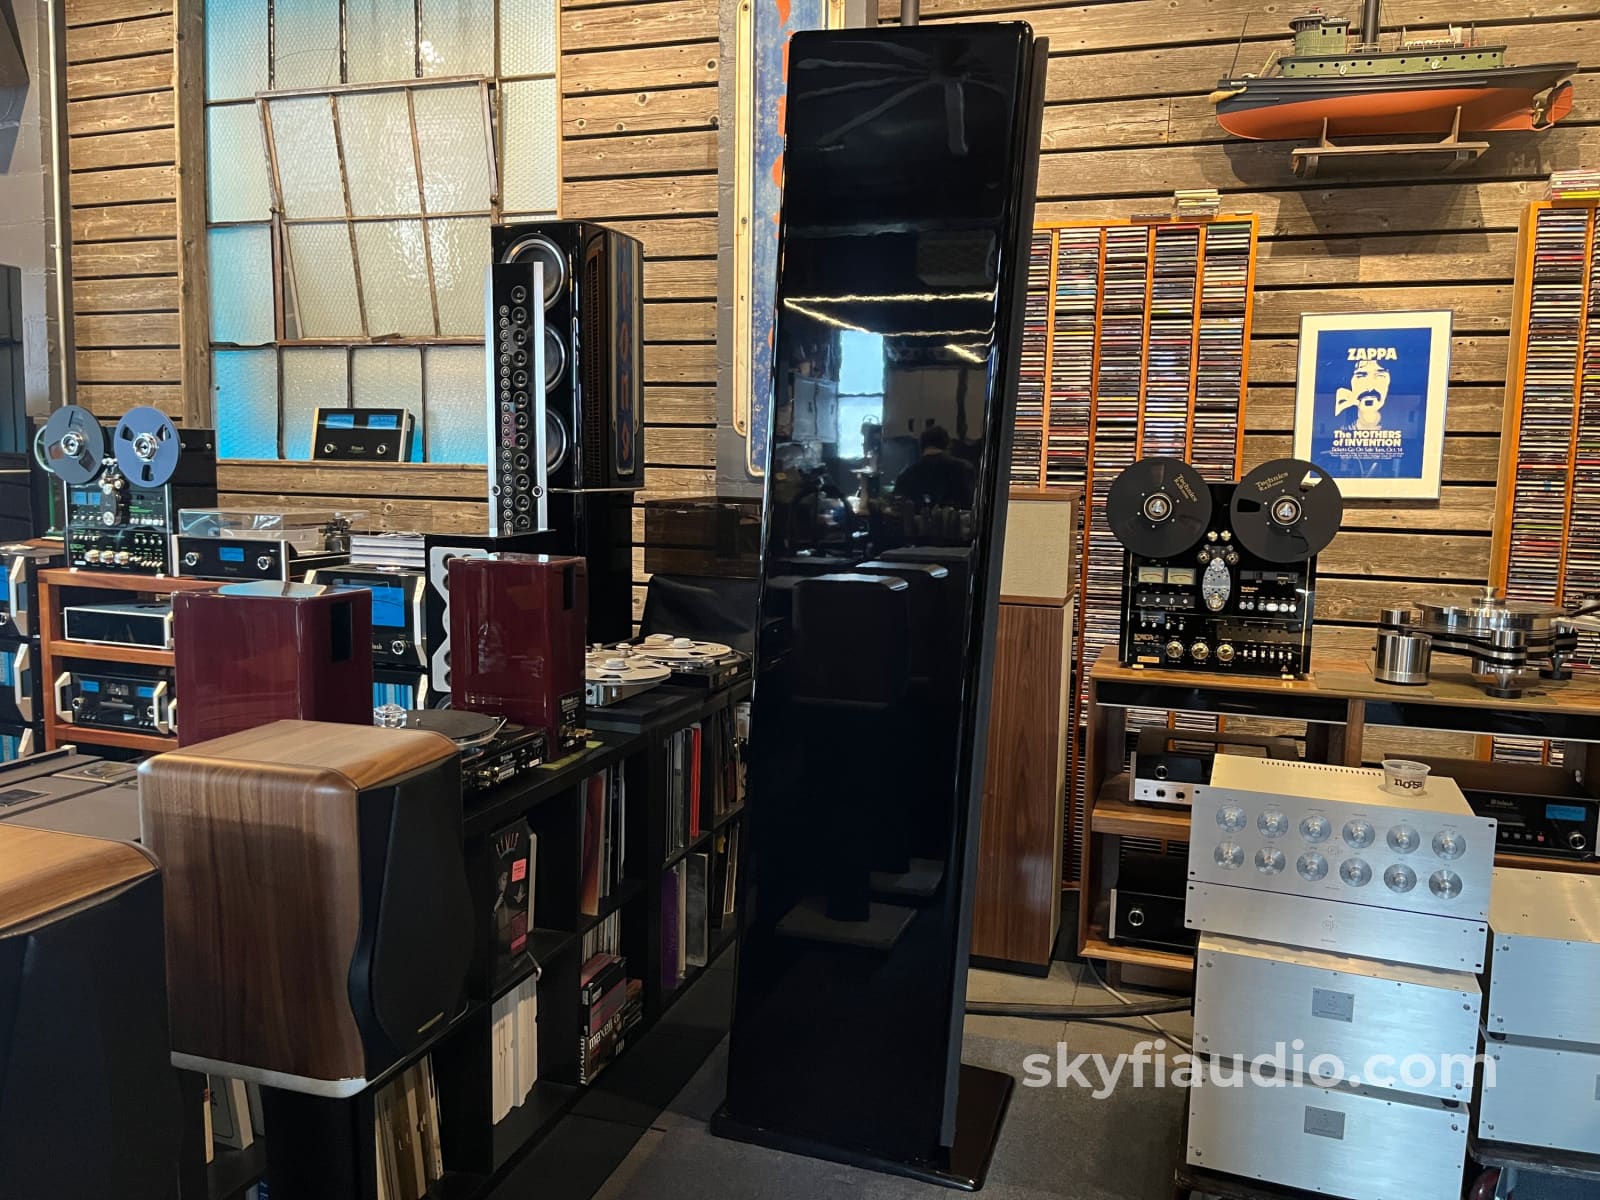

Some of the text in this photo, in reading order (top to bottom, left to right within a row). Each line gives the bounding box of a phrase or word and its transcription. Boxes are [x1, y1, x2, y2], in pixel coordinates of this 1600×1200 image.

[1347, 347, 1398, 361] ZAPPA
[1333, 430, 1402, 439] The MOTHERS
[1333, 438, 1402, 447] of INVENTION
[589, 1014, 613, 1050] maxell
